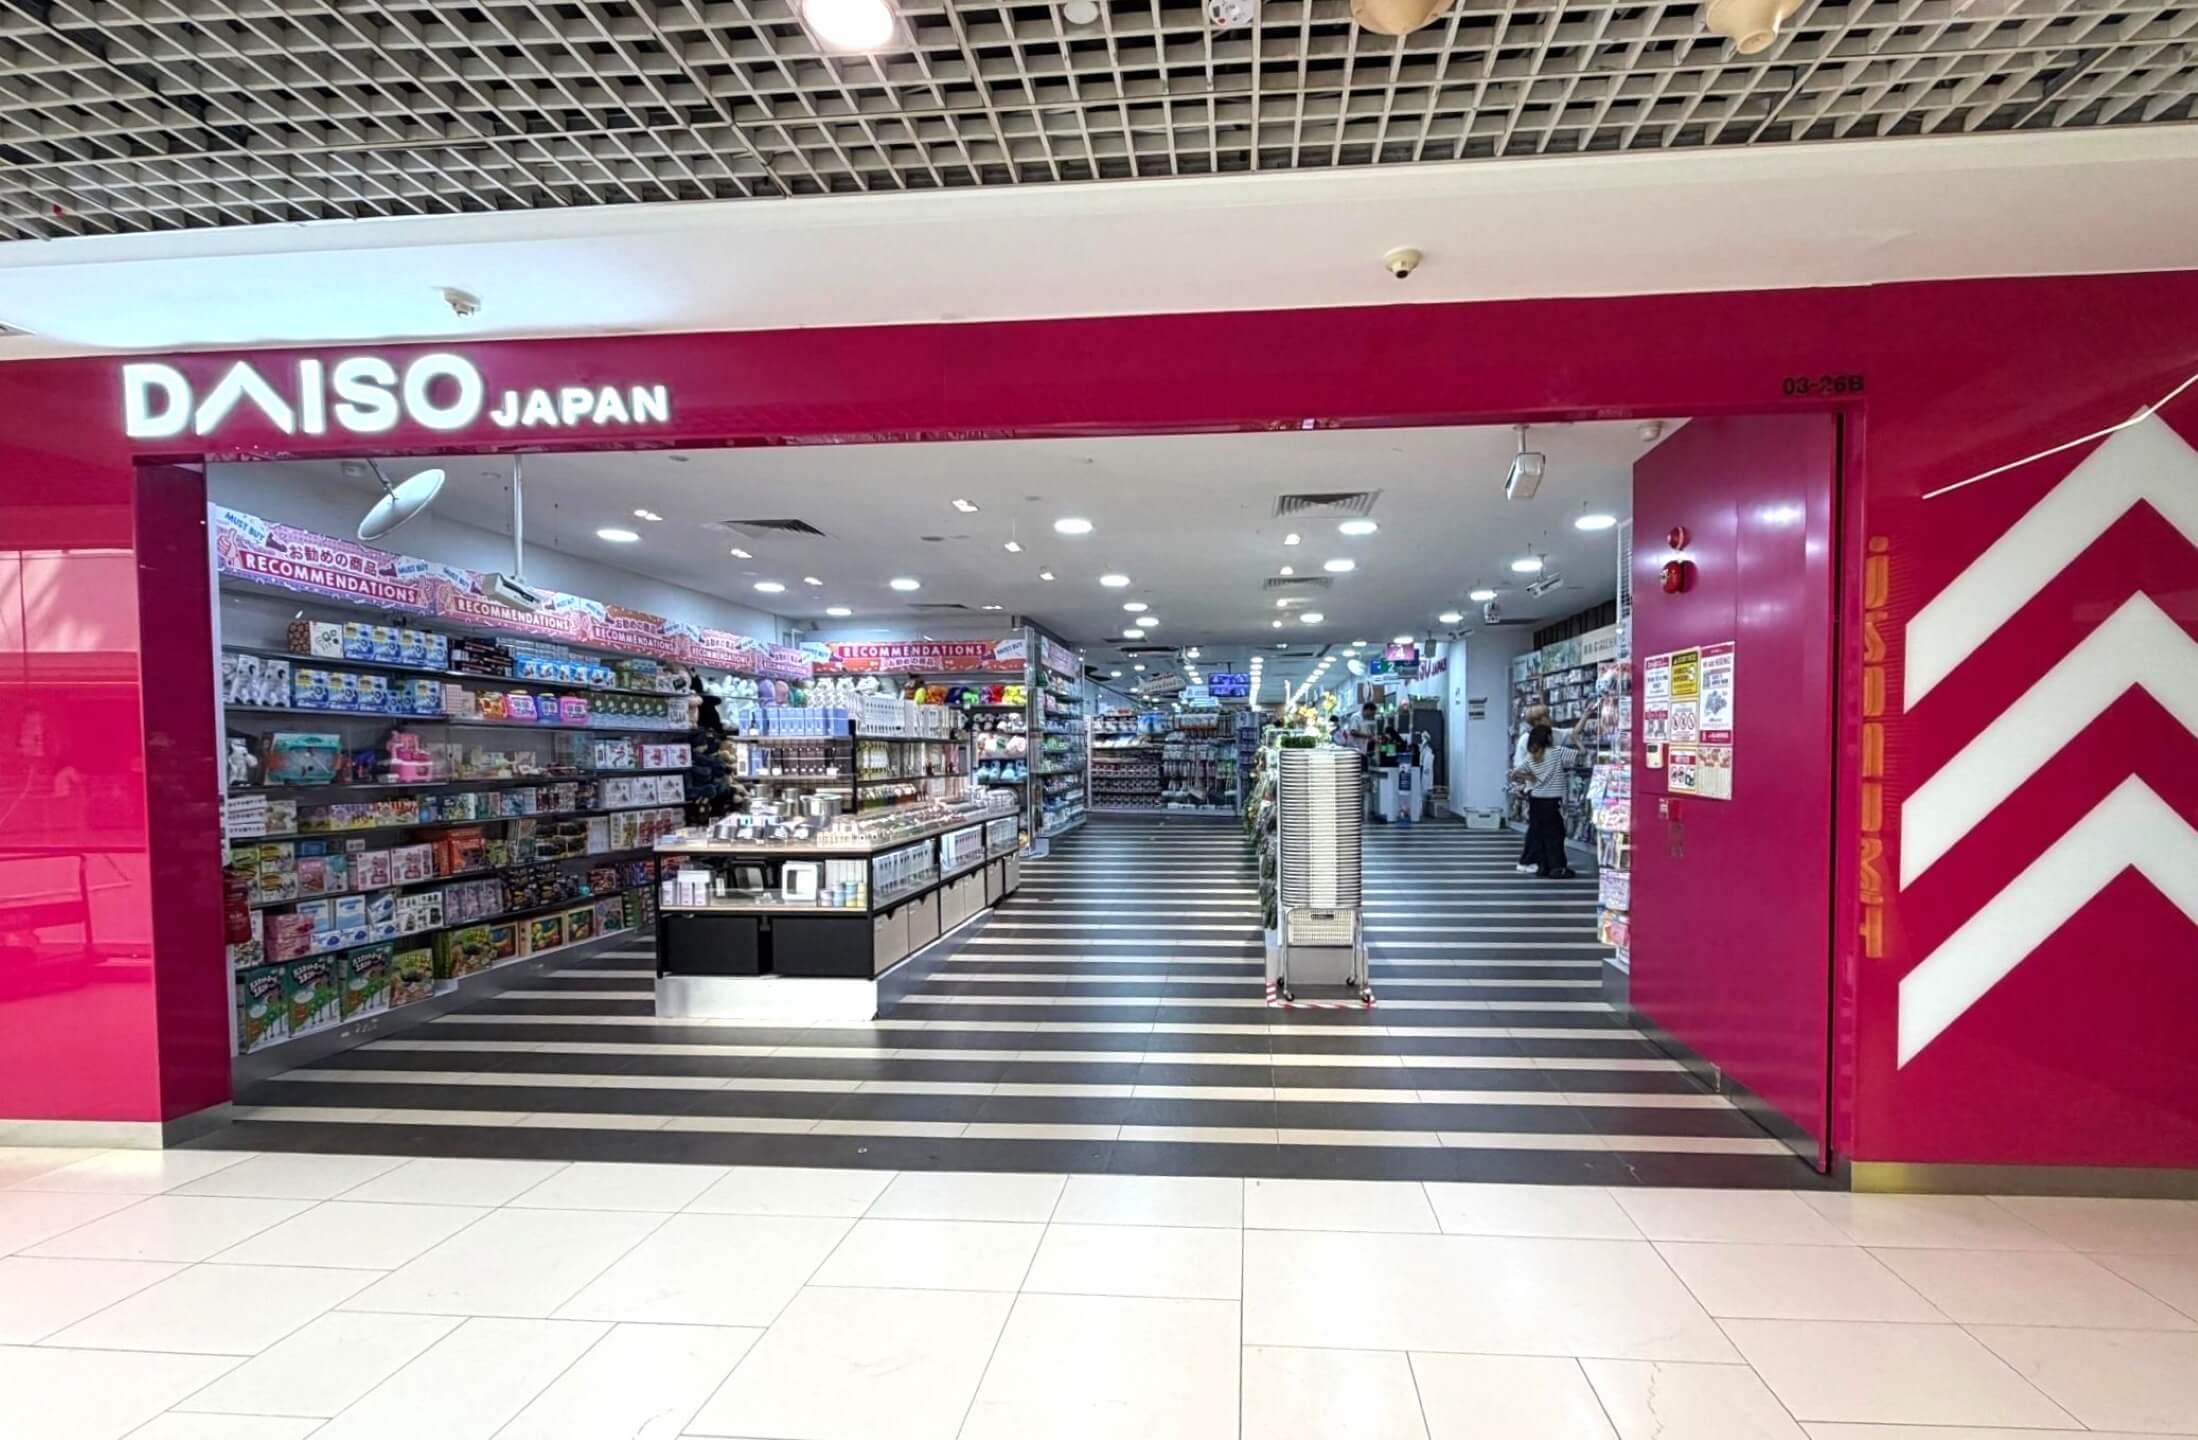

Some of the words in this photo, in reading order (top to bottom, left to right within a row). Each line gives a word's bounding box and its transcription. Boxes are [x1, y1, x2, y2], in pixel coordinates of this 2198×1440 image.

[122, 352, 485, 438] DAISO
[490, 384, 670, 428] JAPAN
[1782, 374, 1865, 395] 03-26B
[224, 511, 249, 532] MUST
[247, 524, 266, 542] BUY
[288, 543, 379, 577] お勧めの商品
[397, 564, 415, 575] MUST
[415, 563, 429, 573] BUY
[244, 554, 418, 604] RECOMMENDATIONS
[457, 599, 570, 632] RECOMMENDATIONS
[594, 626, 675, 652] RECOMMENDATIONS
[843, 645, 983, 657] RECOMMENDATIONS
[996, 645, 1010, 656] MUST
[1010, 641, 1024, 651] BUY
